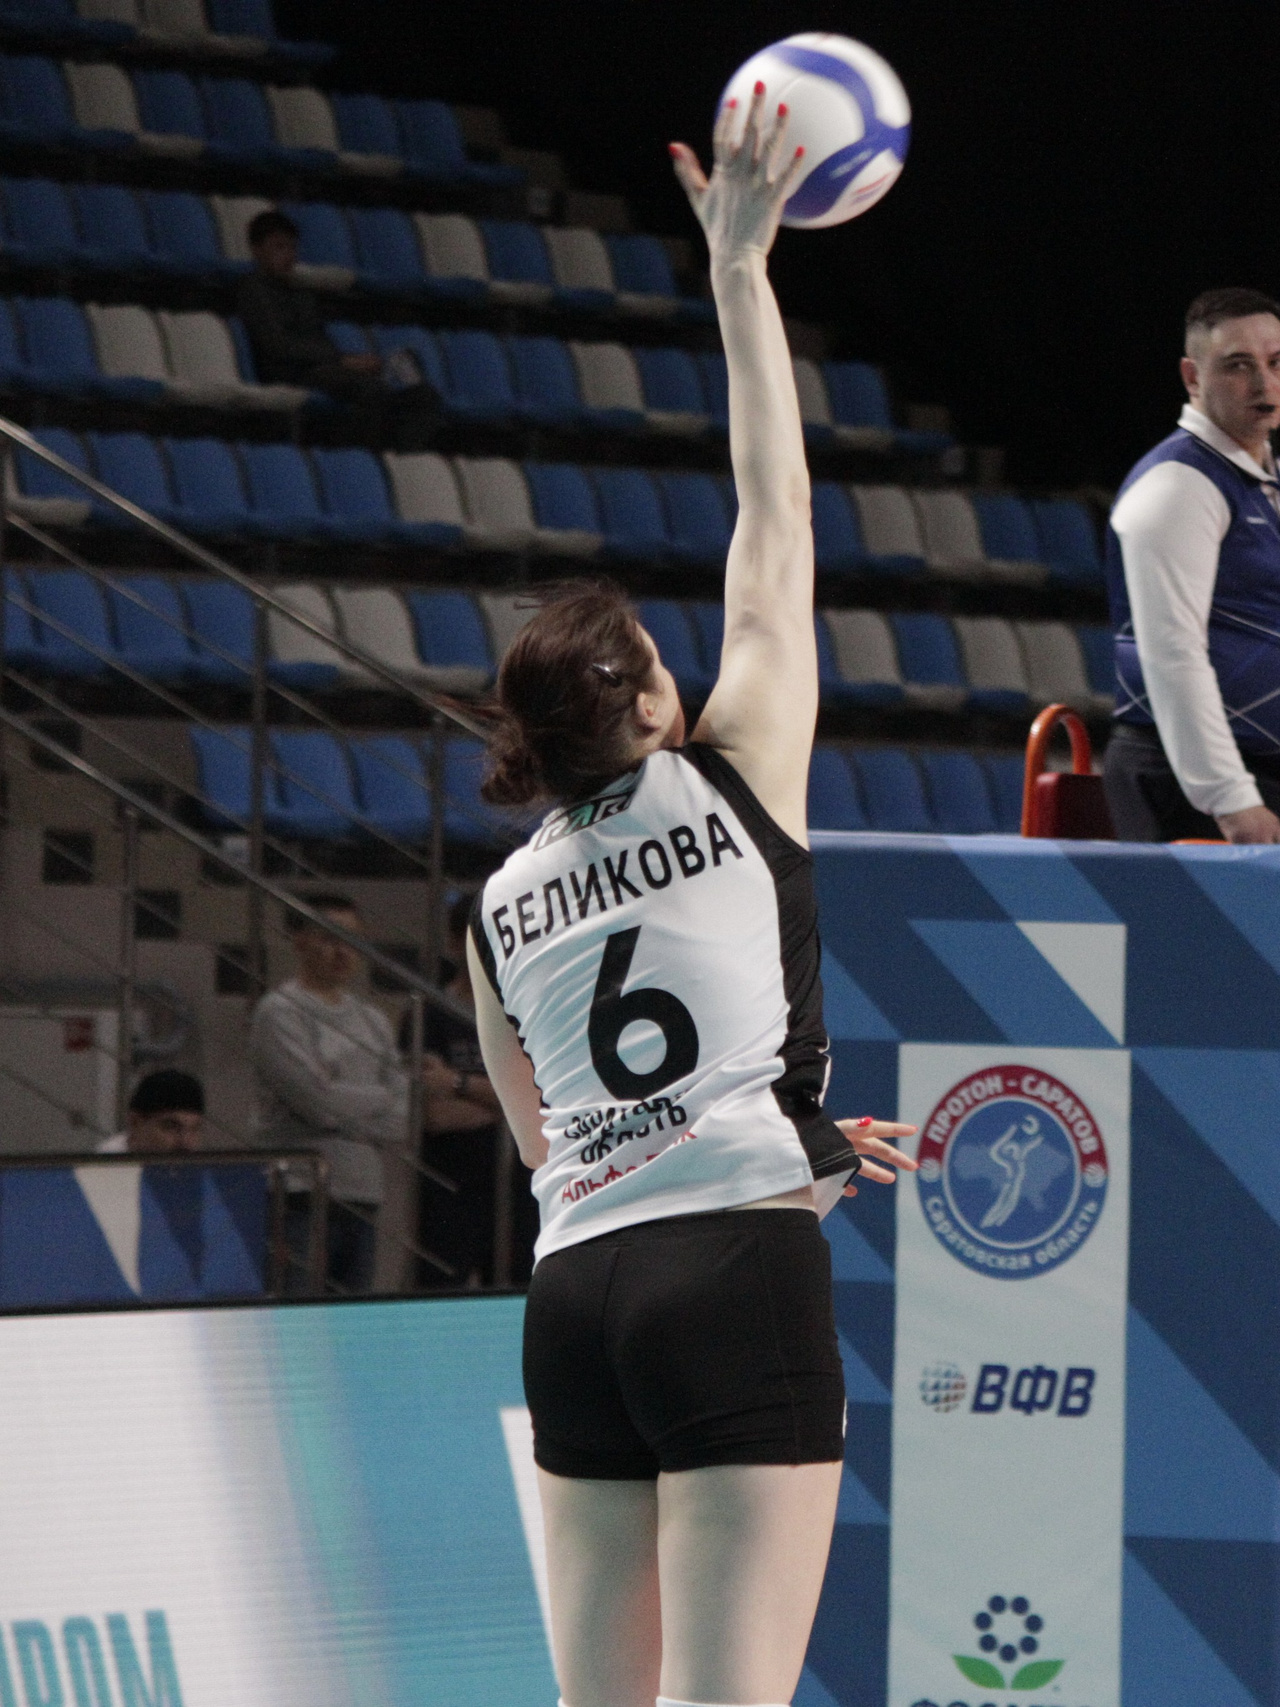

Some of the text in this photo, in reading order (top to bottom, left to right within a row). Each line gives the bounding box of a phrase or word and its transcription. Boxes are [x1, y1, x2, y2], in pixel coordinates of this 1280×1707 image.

[491, 812, 743, 960] БЕЛИКОВА
[587, 925, 699, 1101] 6
[926, 1075, 1004, 1145] ПРОТОН
[1021, 1074, 1098, 1155] САРАТОВ
[925, 1195, 1098, 1271] Саратовская область
[970, 1363, 1095, 1417] ВФВ
[0, 1608, 185, 1707] РОМ
